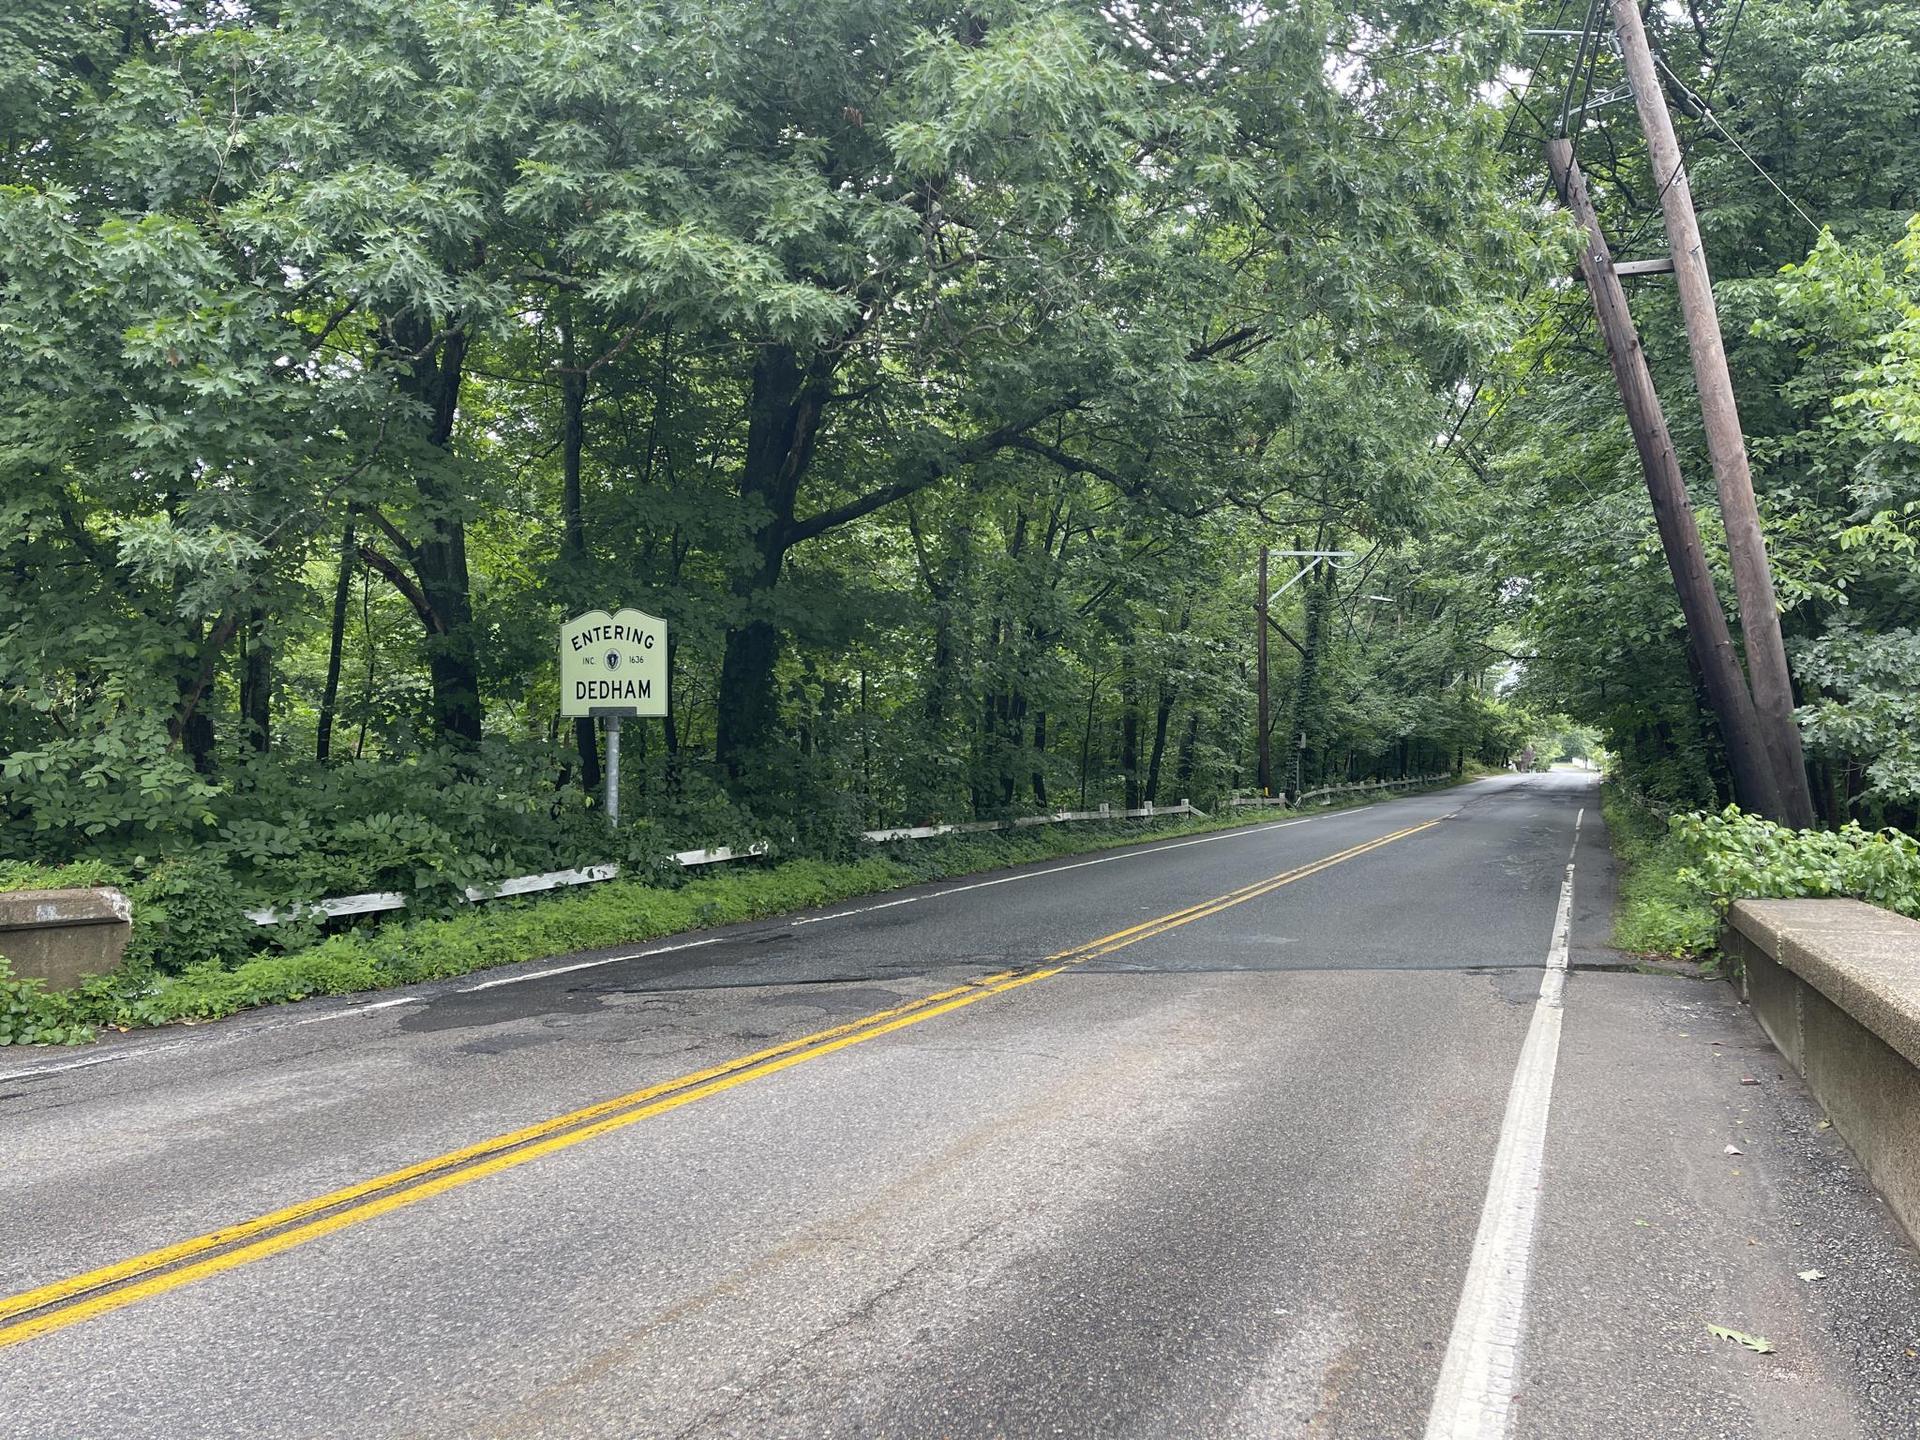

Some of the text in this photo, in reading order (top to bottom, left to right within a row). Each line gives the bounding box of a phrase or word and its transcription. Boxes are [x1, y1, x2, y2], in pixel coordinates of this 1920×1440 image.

[571, 625, 654, 651] ENTERING
[629, 656, 644, 664] 1636
[576, 680, 651, 700] DEDHAM
